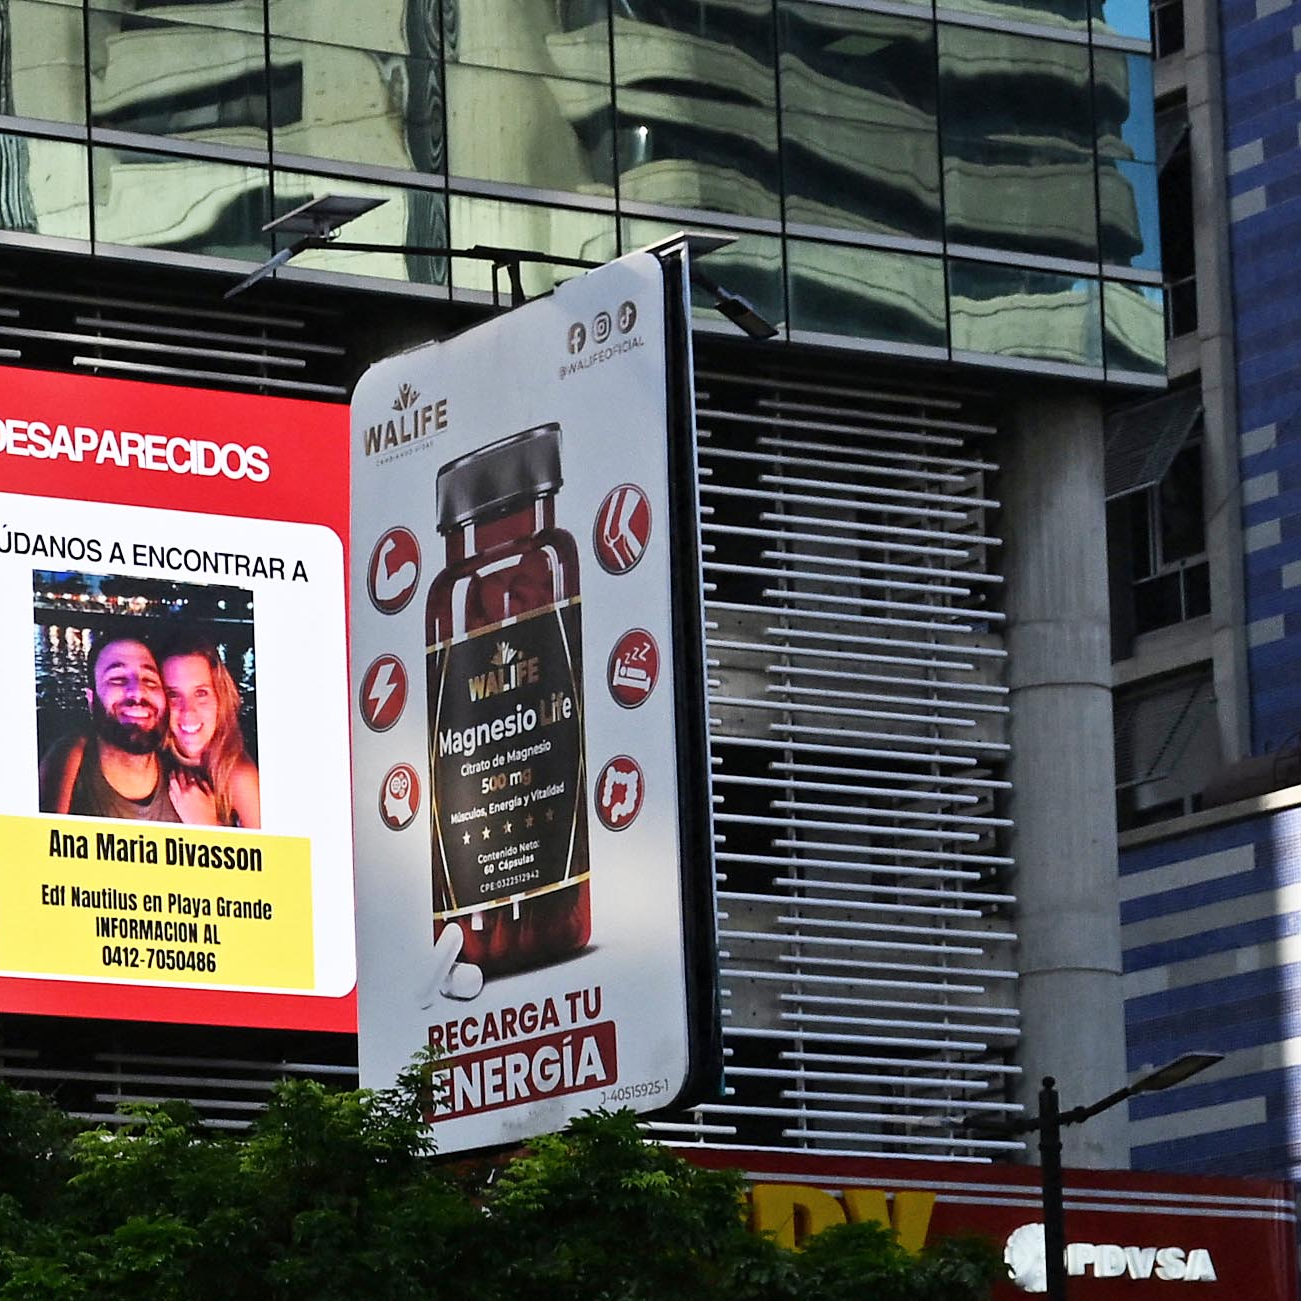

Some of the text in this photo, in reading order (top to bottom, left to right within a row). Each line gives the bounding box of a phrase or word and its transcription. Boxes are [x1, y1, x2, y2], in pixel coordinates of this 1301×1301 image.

[364, 399, 447, 457] WALIFE
[109, 542, 126, 565] A
[133, 543, 286, 581] ENCONTRAR
[291, 560, 309, 583] A
[468, 657, 539, 702] WALIFE
[439, 691, 572, 757] Magnesio Life
[460, 740, 552, 777] Citrato de Magnesio
[481, 768, 532, 794] 500 mg
[523, 794, 530, 807] y
[530, 782, 564, 802] Vitalidad
[49, 829, 263, 872] Ana Maria Divasson
[478, 845, 518, 864] Contenido
[484, 854, 535, 875] 60 Cápsulas
[41, 884, 273, 920] Edf Nautilus en Playa Grande
[95, 917, 221, 945] INFORMACION AL
[102, 945, 216, 973] 0412-7050486
[428, 986, 601, 1055] RECARGA TU
[431, 1034, 607, 1117] ENERGÍA
[1067, 1243, 1218, 1282] PDVSA
